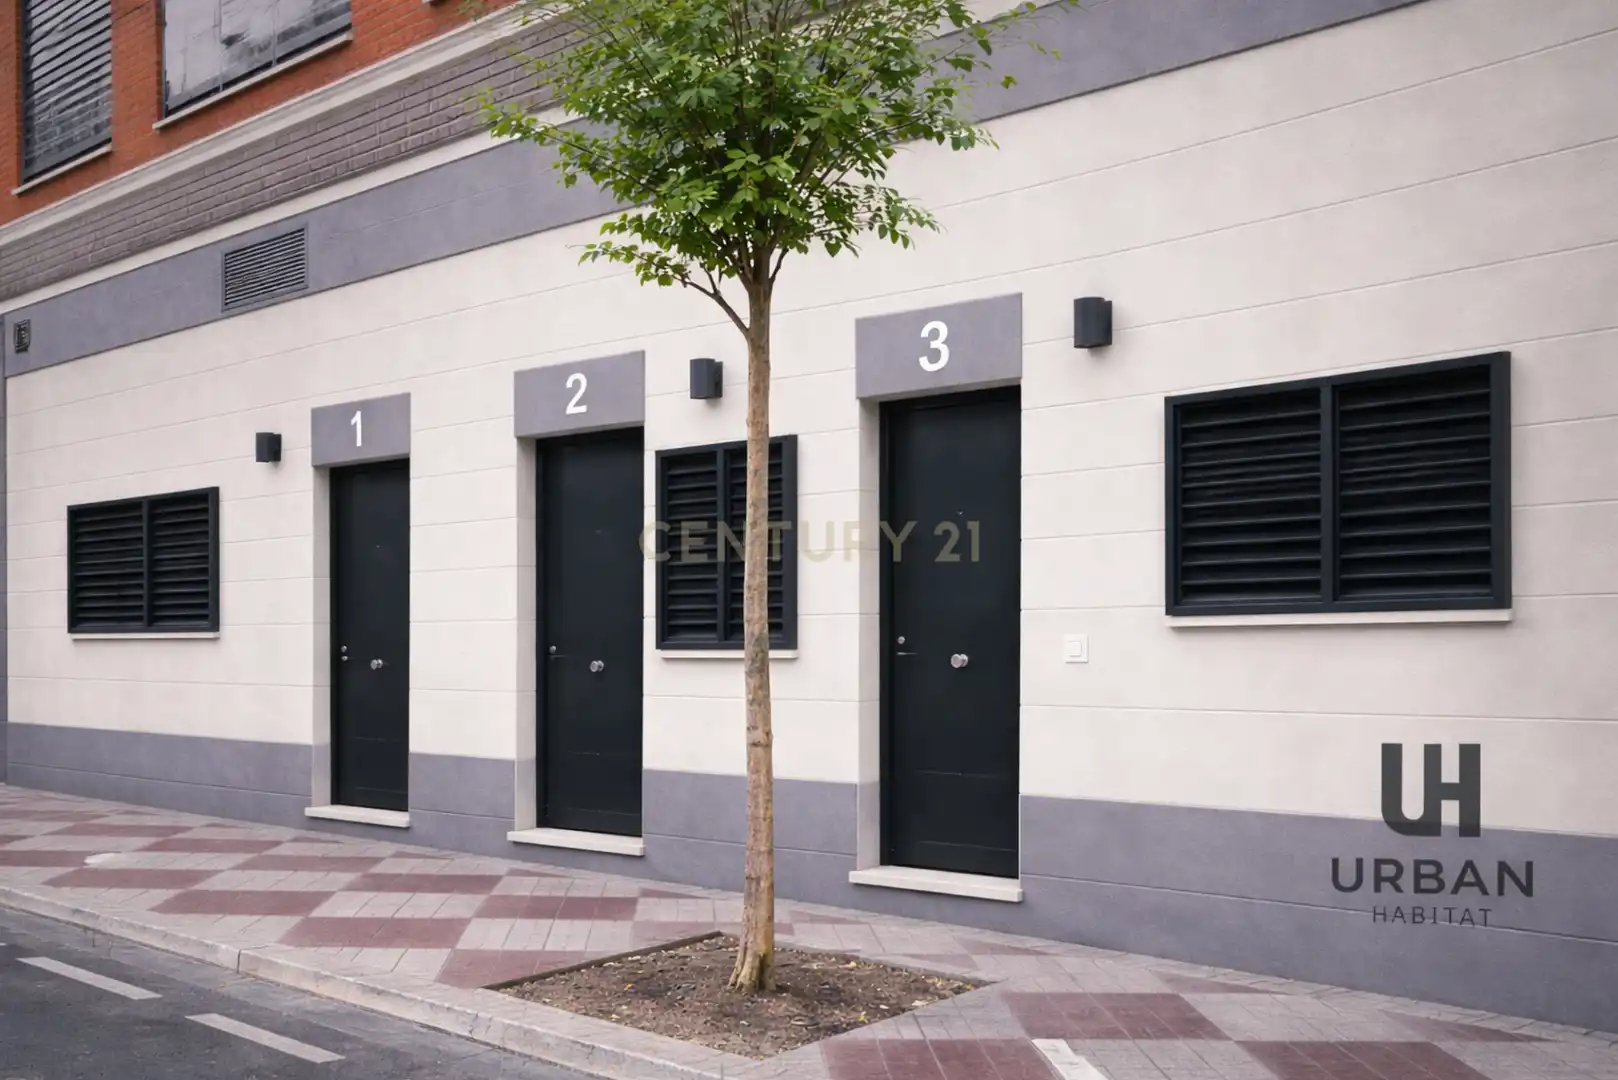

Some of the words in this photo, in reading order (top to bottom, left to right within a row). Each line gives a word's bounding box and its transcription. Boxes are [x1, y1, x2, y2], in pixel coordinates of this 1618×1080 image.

[918, 320, 950, 372] 3
[565, 373, 588, 415] 2
[350, 410, 363, 447] 1
[1331, 857, 1533, 897] URBAN
[1372, 905, 1492, 927] HABITAT
